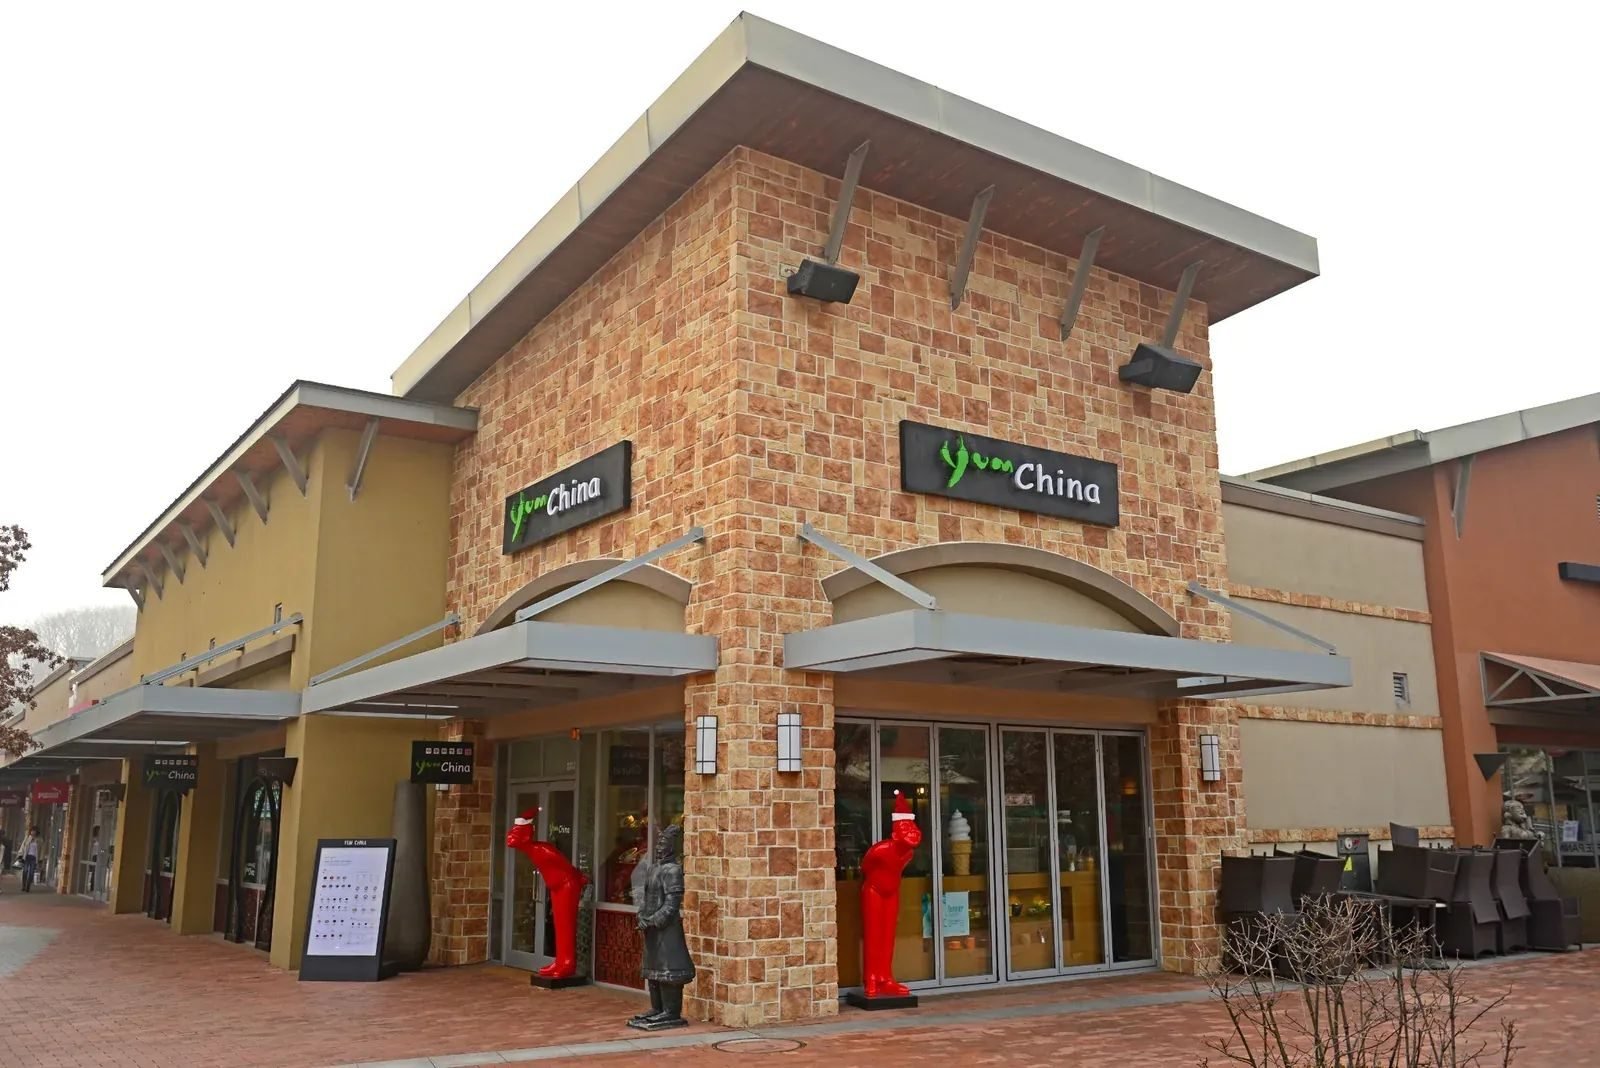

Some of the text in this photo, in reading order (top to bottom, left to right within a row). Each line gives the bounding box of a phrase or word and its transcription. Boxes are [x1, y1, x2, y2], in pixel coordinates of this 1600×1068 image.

[1014, 463, 1101, 504] China
[546, 477, 600, 516] China
[168, 770, 195, 780] China
[441, 761, 471, 773] China
